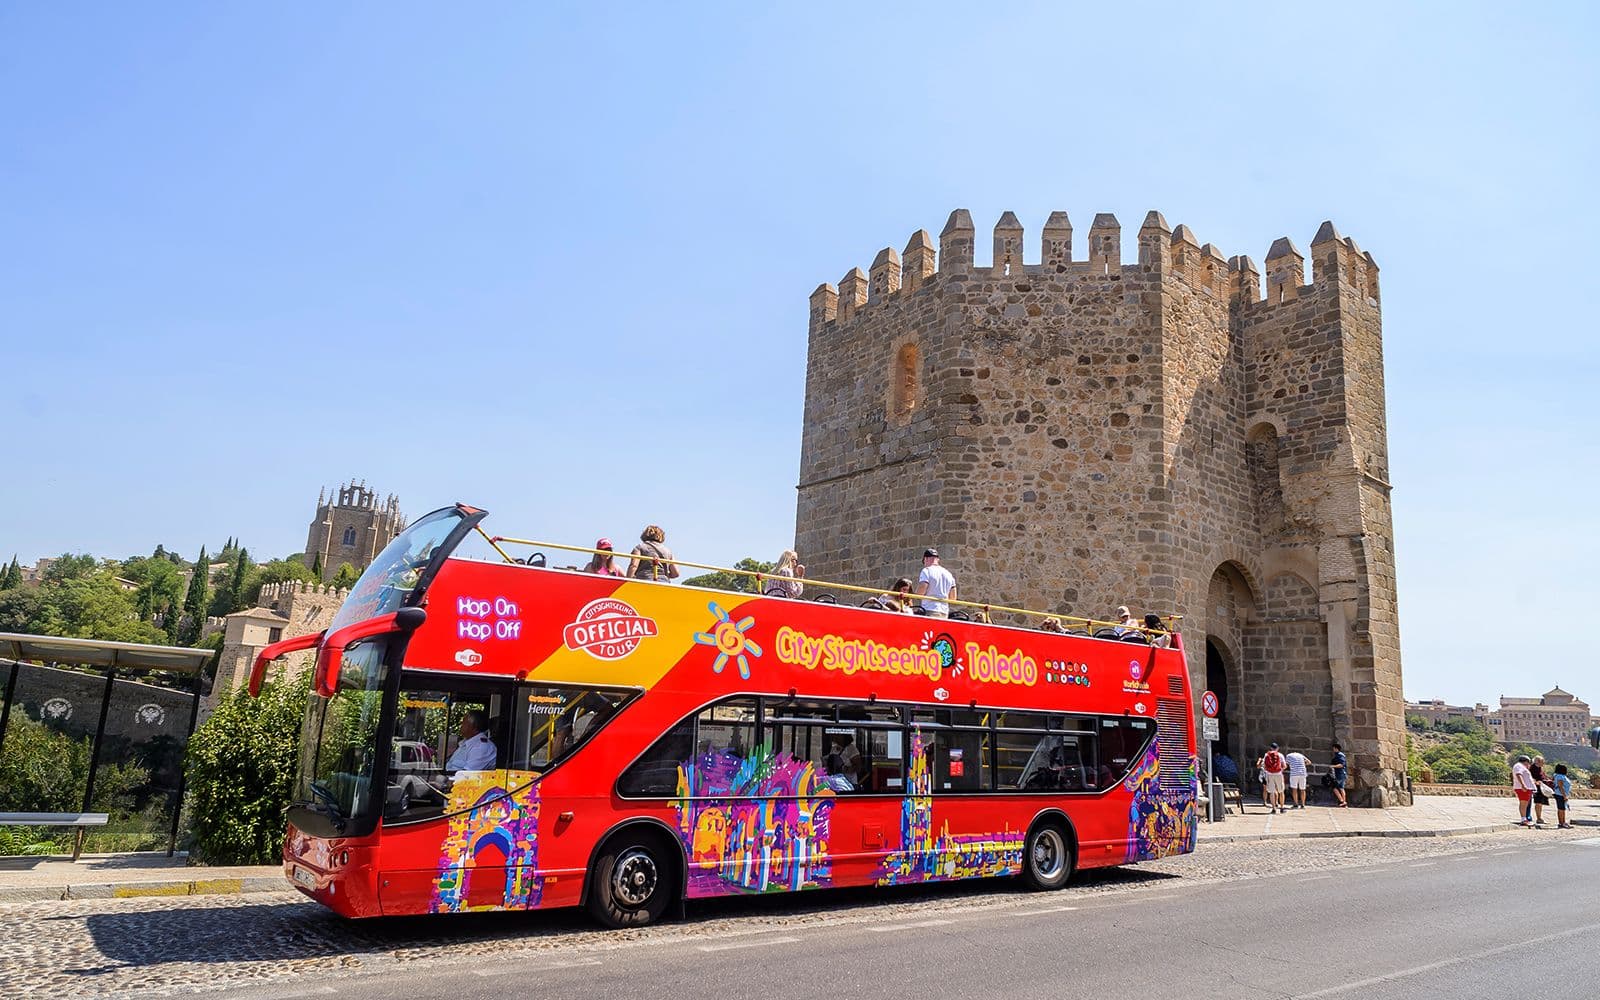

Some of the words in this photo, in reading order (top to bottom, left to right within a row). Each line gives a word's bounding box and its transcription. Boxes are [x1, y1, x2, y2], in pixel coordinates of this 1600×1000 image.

[457, 597, 491, 618] Hop
[494, 597, 518, 617] On
[585, 602, 633, 619] CITYSIGHTSEEING
[458, 619, 492, 641] Hop
[495, 619, 521, 639] Off
[573, 620, 653, 645] OFFICIAL
[599, 640, 635, 657] TOUR
[966, 641, 1038, 686] Toledo
[527, 703, 566, 715] Herranz
